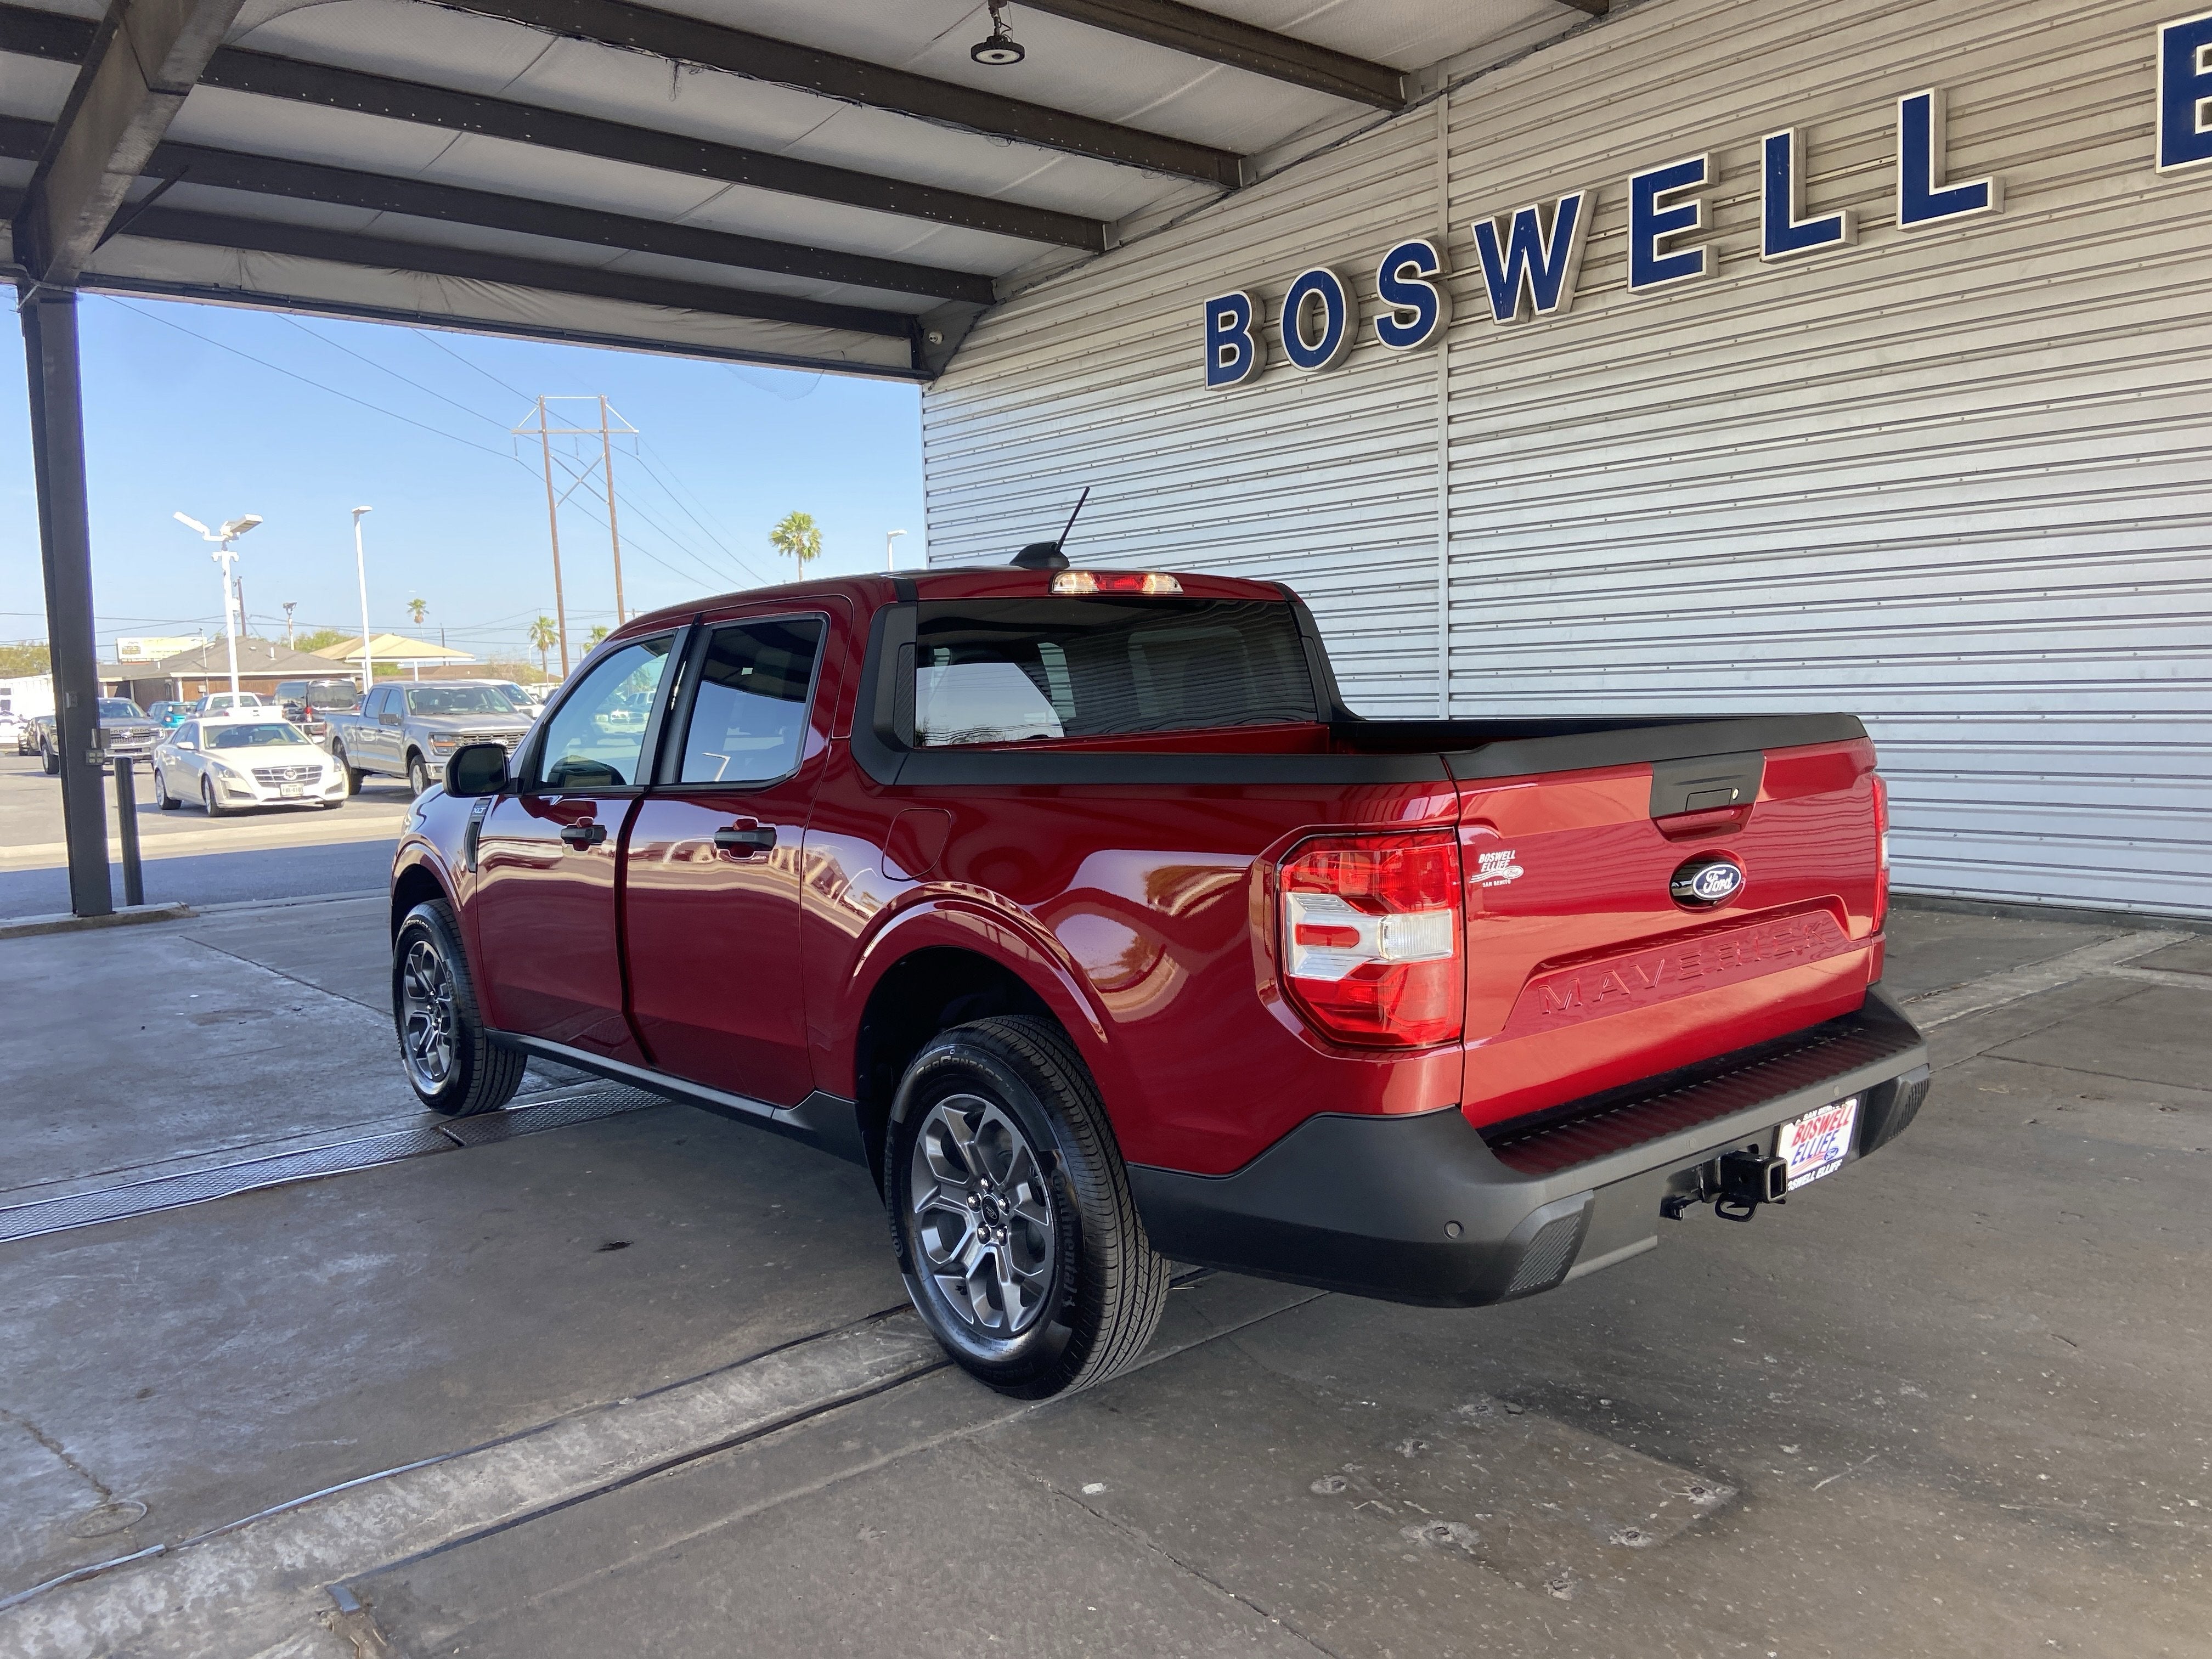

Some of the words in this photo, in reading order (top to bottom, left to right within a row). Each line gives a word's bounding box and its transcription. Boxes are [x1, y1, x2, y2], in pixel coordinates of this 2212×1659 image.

[1204, 87, 2000, 391] BOSWELL
[1478, 850, 1516, 864] BOSWELL
[1703, 869, 1734, 894] Ford
[1536, 921, 1826, 1015] MAVERICK
[1791, 1105, 1854, 1148] BOSWELL
[1791, 1129, 1839, 1166] ELLIFF
[1815, 1159, 1843, 1179] ELLIFF
